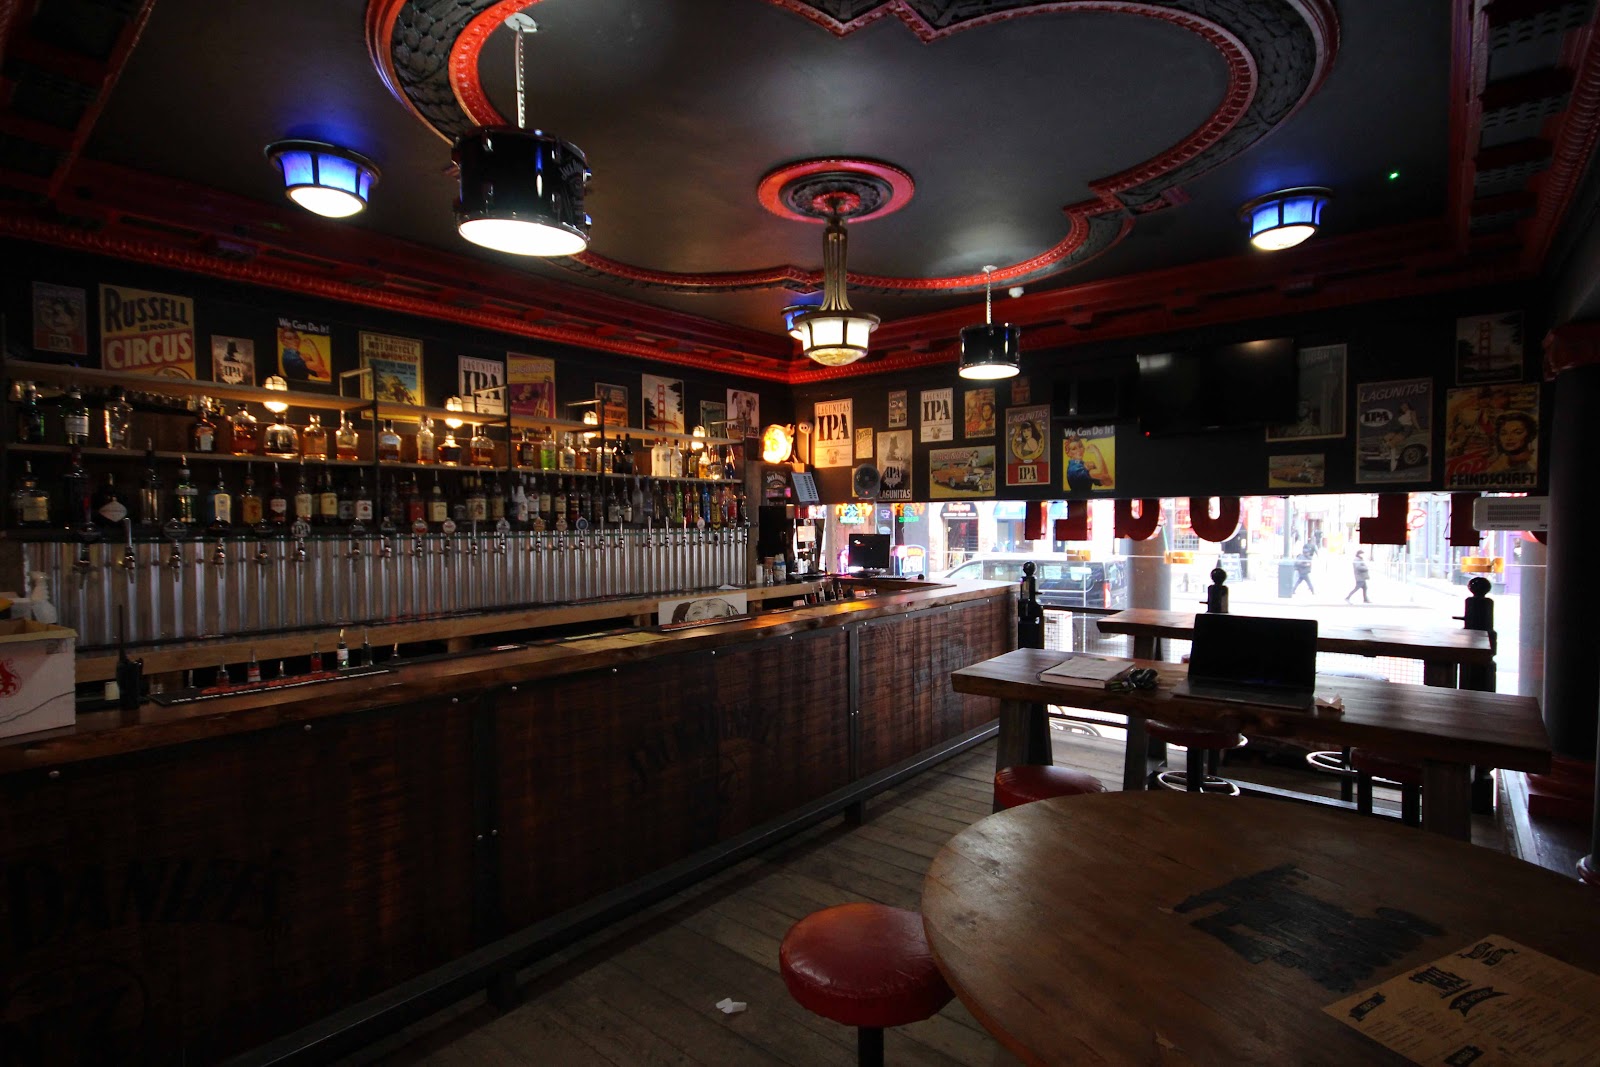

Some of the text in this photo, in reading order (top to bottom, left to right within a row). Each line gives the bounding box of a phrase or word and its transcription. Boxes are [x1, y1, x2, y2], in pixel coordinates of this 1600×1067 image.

[104, 288, 188, 332] RUSSELL
[278, 317, 291, 328] We
[292, 320, 307, 330] Can
[308, 322, 319, 332] Do
[107, 332, 192, 369] CIRCUS
[224, 366, 242, 378] IPA
[463, 370, 501, 400] IPA
[1361, 382, 1428, 403] LAGUNITAS
[817, 402, 850, 415] LAGUNITAS
[924, 400, 951, 421] IPA
[1008, 409, 1048, 424] LAGUNITAS
[1364, 411, 1390, 422] IPA
[818, 413, 850, 441] IPA
[1064, 424, 1115, 437] We Can Do It!
[886, 466, 900, 478] IPA
[1019, 466, 1036, 480] IPA
[1450, 471, 1537, 487] FEINDSCHAFT
[880, 488, 911, 499] LAGUNITAS
